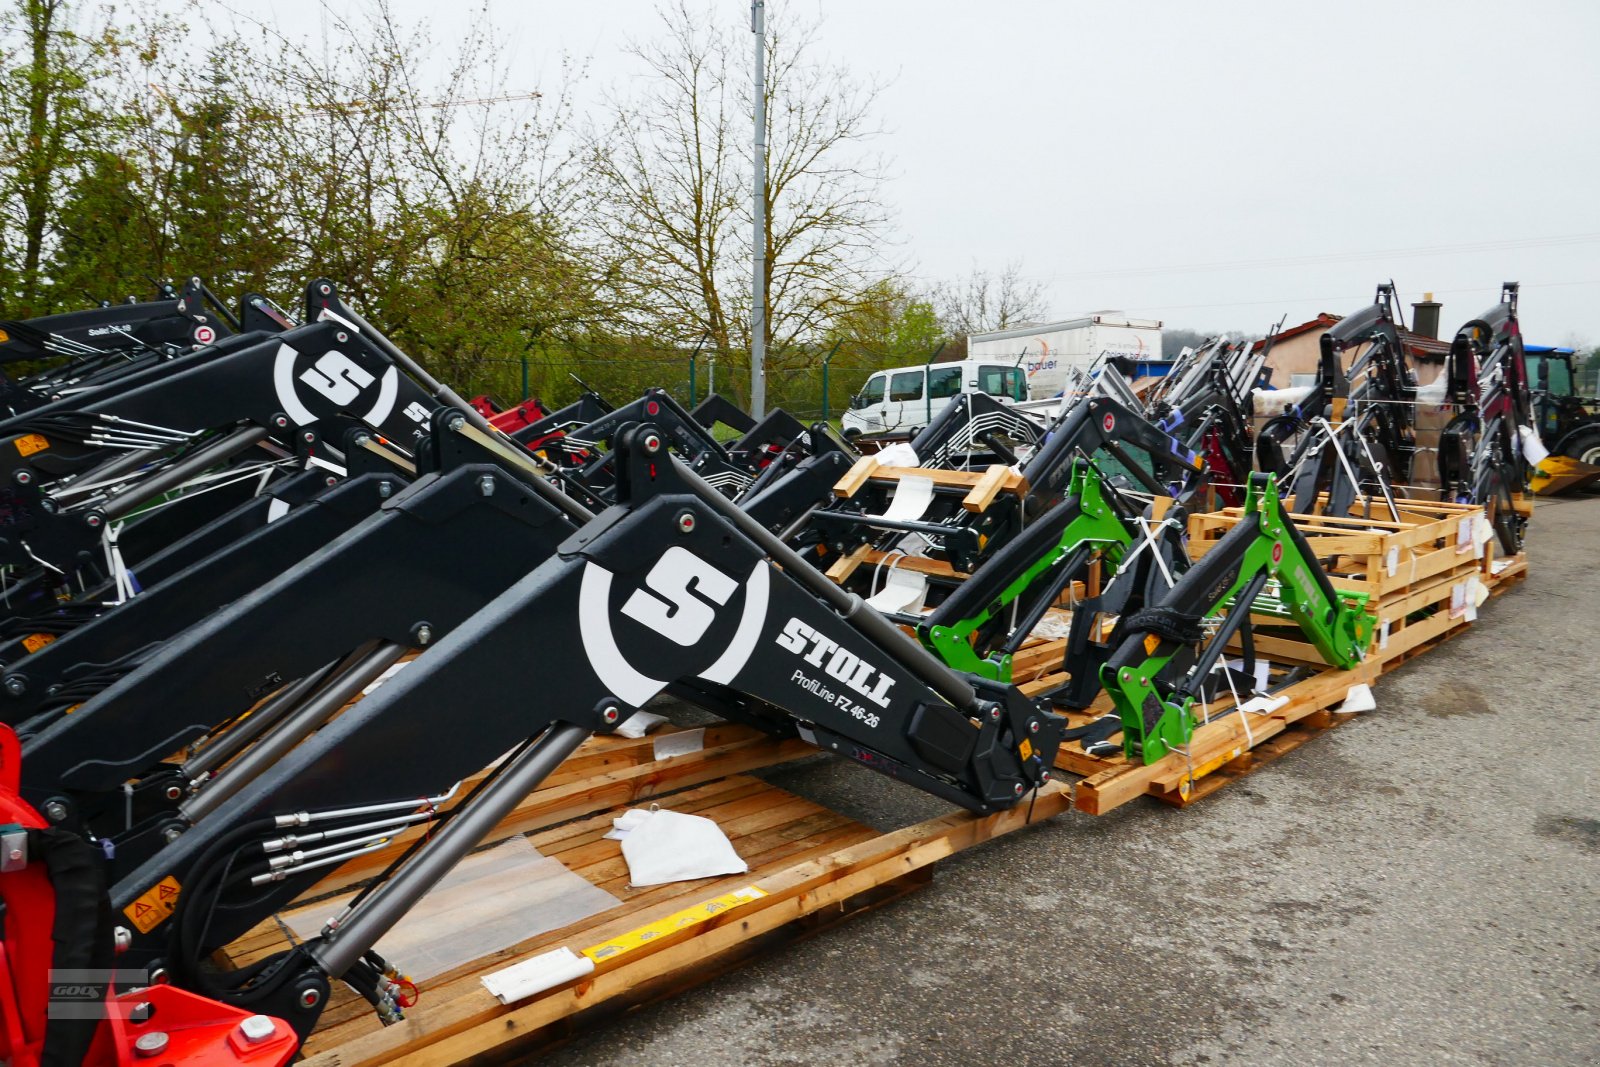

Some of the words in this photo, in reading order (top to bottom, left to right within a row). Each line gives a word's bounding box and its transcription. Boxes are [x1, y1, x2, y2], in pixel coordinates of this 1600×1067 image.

[1028, 359, 1058, 371] bauer
[775, 617, 897, 709] STOLL
[790, 669, 836, 703] ProfiLine
[834, 694, 853, 713] FZ
[850, 705, 881, 729] 46-26
